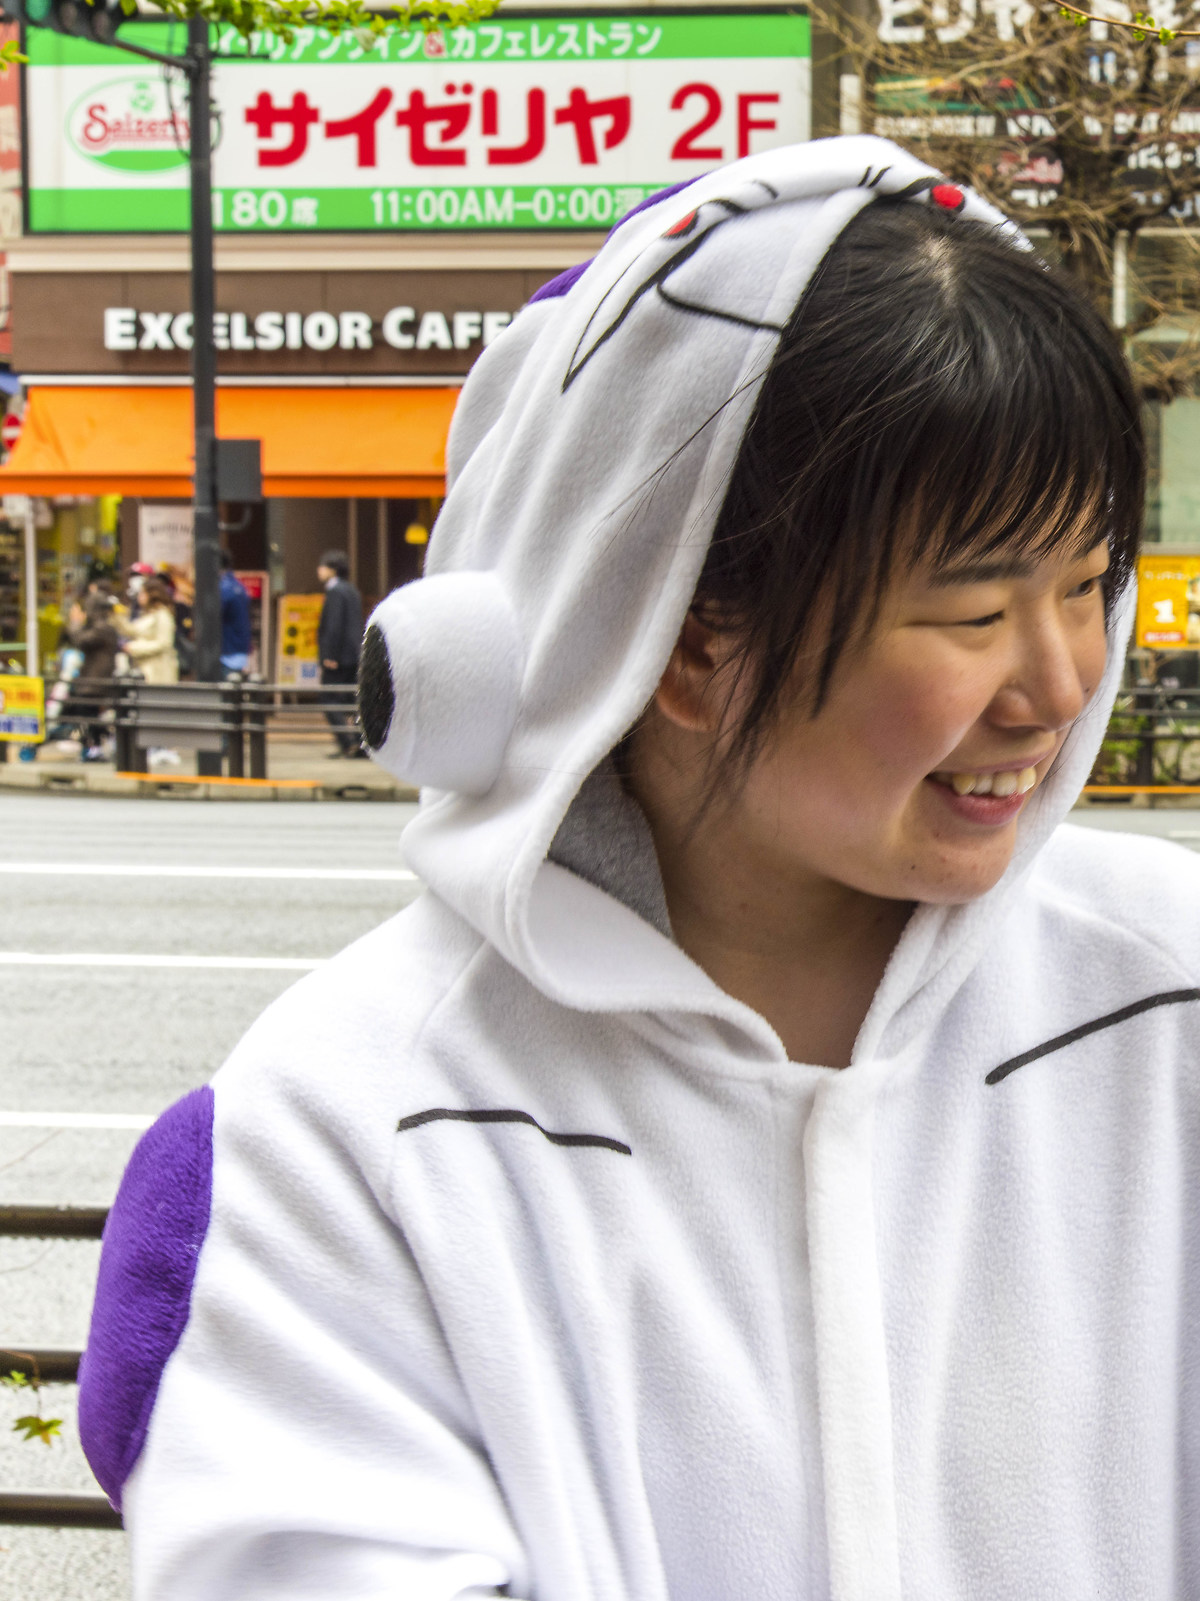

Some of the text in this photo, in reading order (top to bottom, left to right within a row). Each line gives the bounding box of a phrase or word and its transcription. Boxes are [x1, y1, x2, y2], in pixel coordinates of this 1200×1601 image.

[245, 82, 780, 167] サイゼリヤ 2F
[103, 306, 521, 351] EXCELSIOR CAFF
